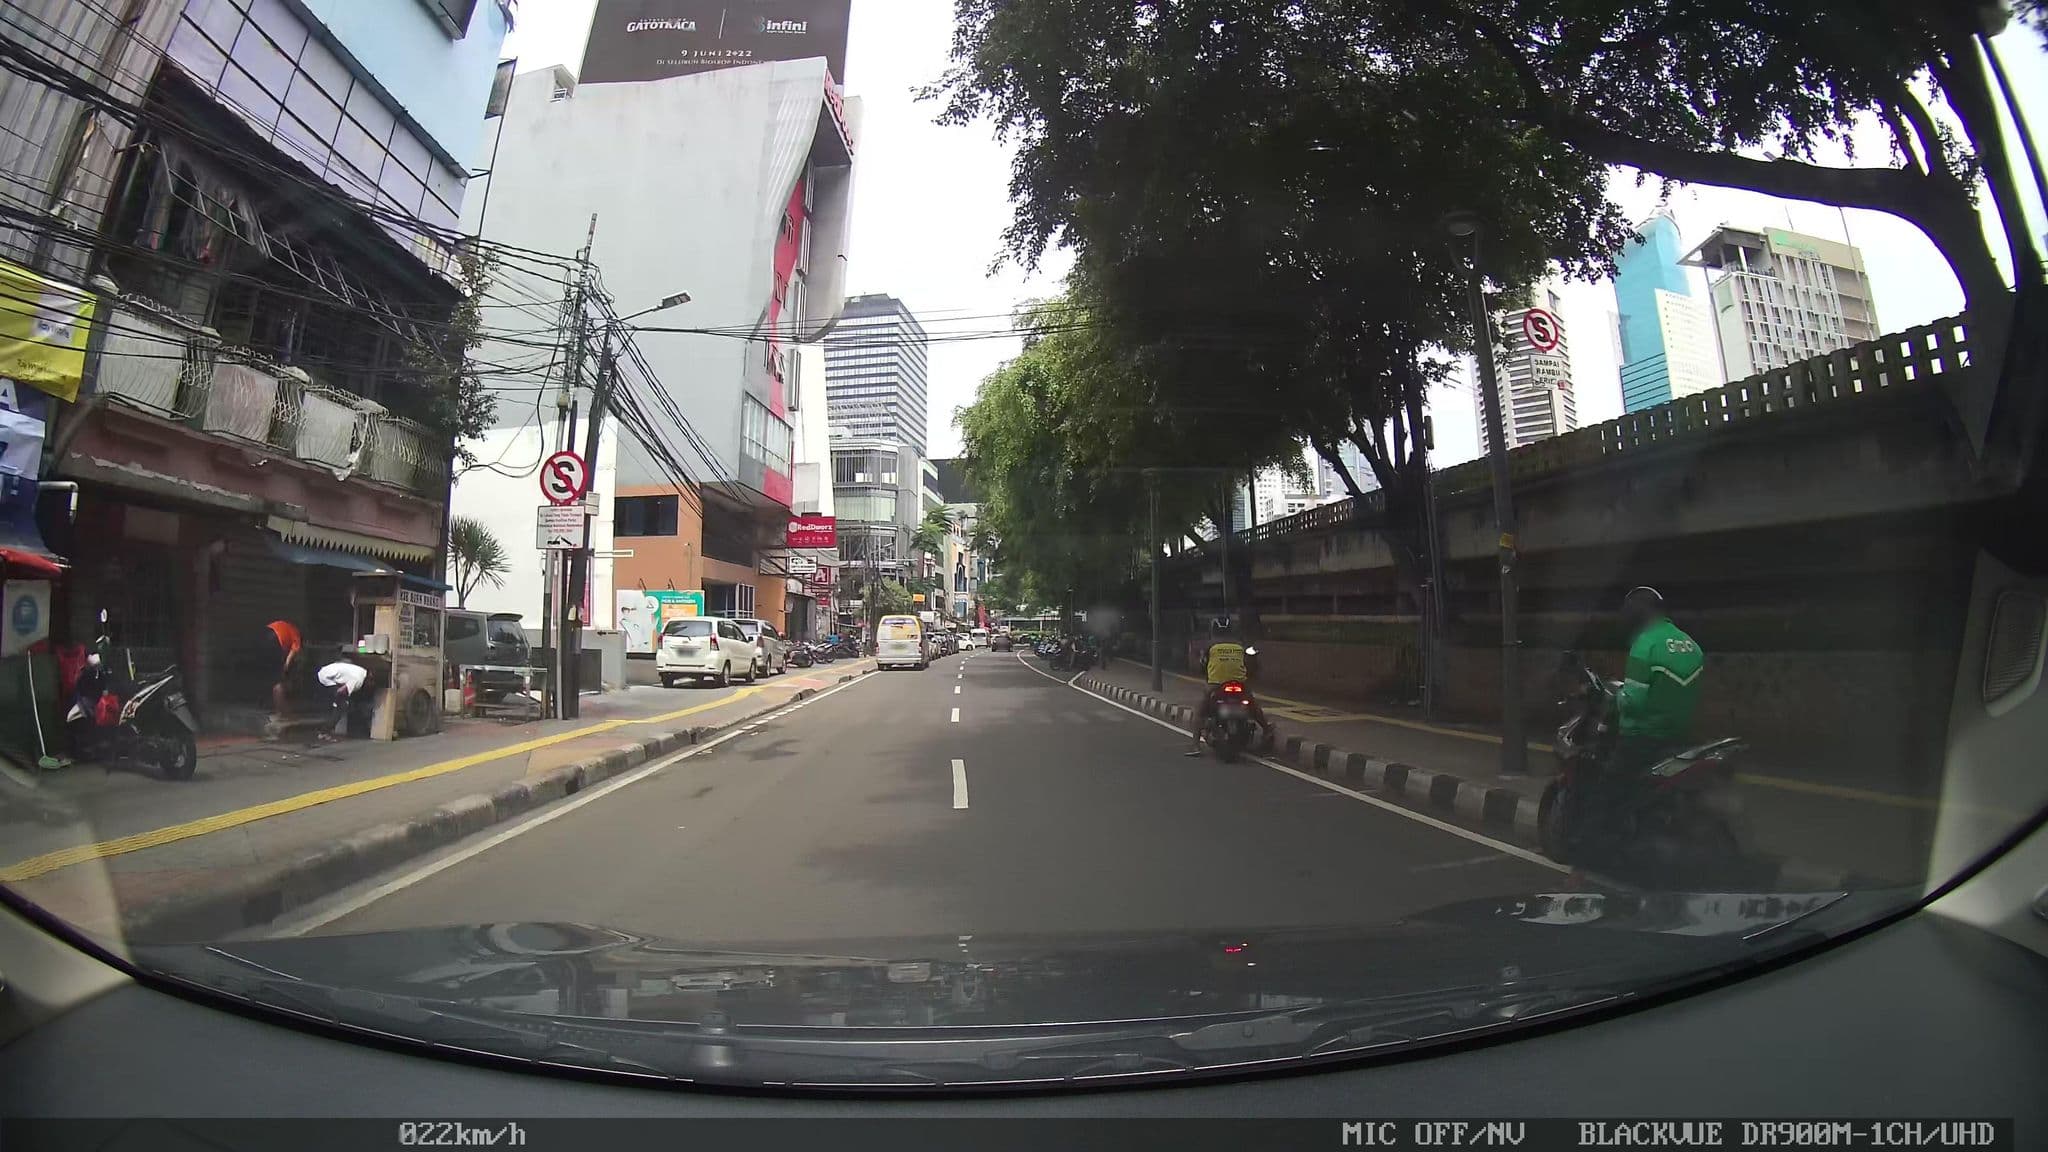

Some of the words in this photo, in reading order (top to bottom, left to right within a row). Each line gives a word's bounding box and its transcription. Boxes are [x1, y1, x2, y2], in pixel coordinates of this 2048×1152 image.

[626, 21, 697, 32] GATOTKACA
[766, 20, 808, 31] infini
[1534, 359, 1560, 368] SAMPAI
